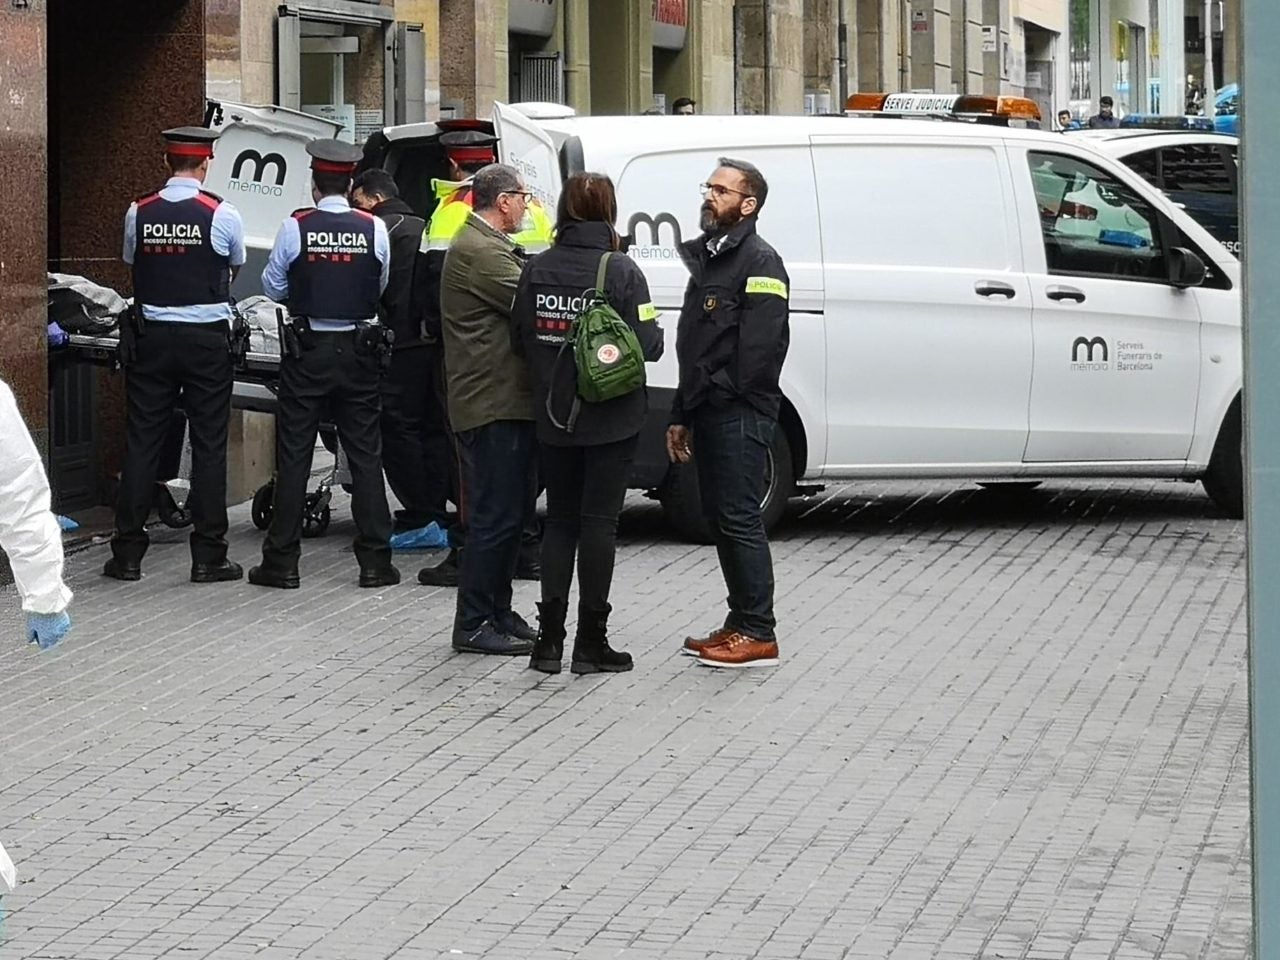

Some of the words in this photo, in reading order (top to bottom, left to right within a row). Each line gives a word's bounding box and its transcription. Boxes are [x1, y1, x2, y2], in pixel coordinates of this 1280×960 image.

[884, 98, 915, 110] SERVEI
[916, 99, 953, 110] JUDICIAL
[143, 223, 202, 238] POLICIA
[307, 231, 368, 246] POLICIA
